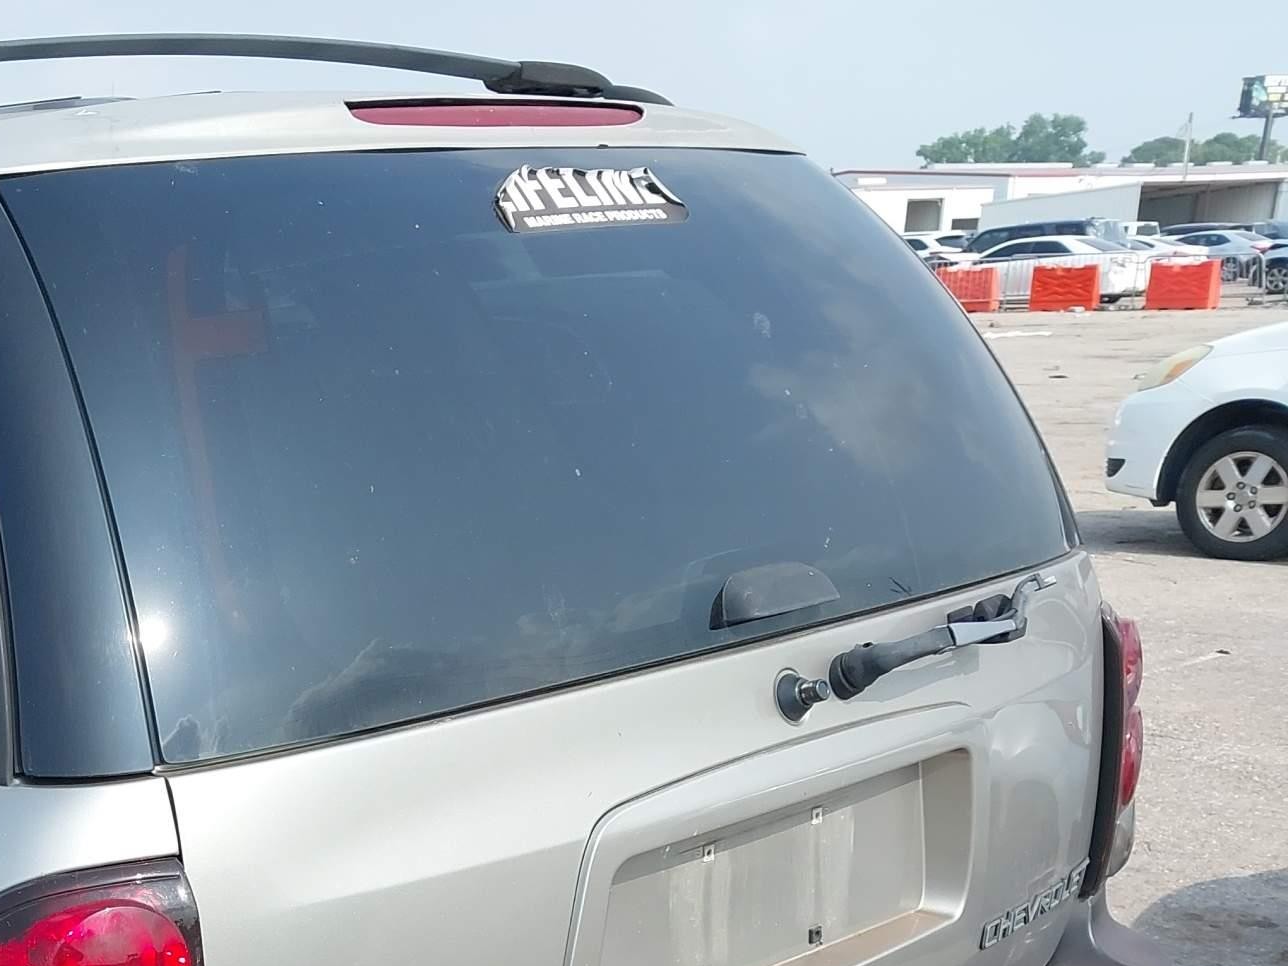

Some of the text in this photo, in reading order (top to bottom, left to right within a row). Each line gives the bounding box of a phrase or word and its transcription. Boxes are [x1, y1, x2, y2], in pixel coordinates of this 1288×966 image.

[523, 208, 668, 228] MARINE RACE PRODUCTS
